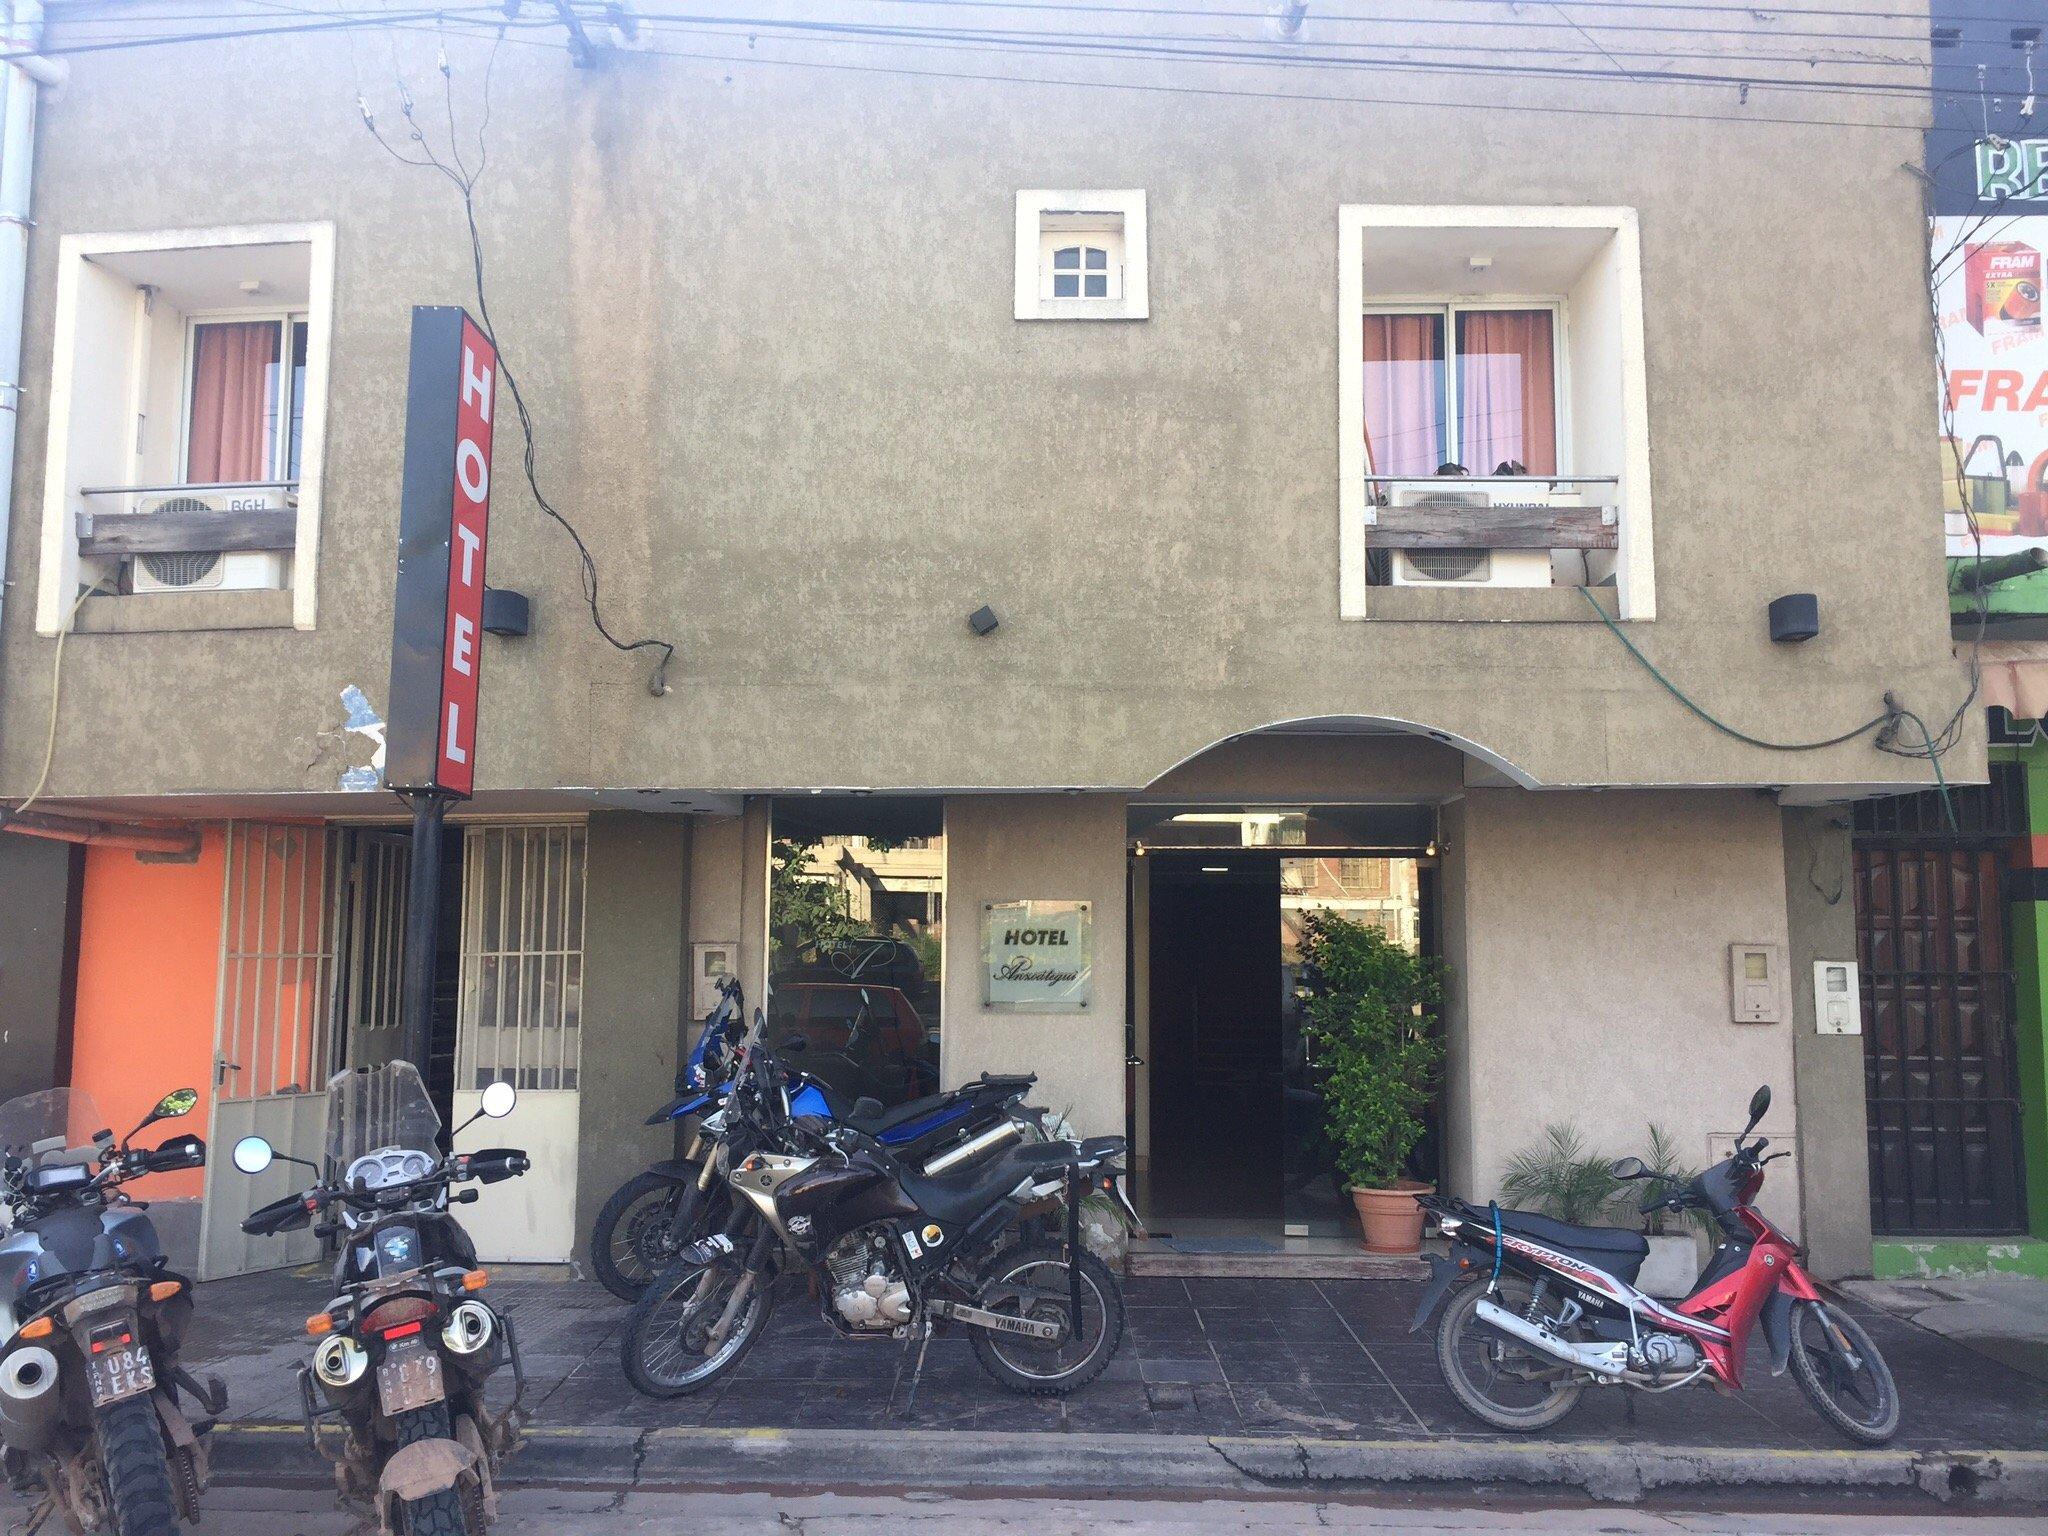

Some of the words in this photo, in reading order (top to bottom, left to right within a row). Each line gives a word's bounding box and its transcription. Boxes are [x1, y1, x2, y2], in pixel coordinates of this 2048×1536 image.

[1990, 255, 2034, 269] FRAM
[231, 499, 265, 511] BGH
[446, 345, 491, 765] HOTEL
[1004, 929, 1069, 946] HOTEL
[1577, 1290, 1605, 1310] YAMAHA
[994, 1317, 1036, 1335] YAMAHA
